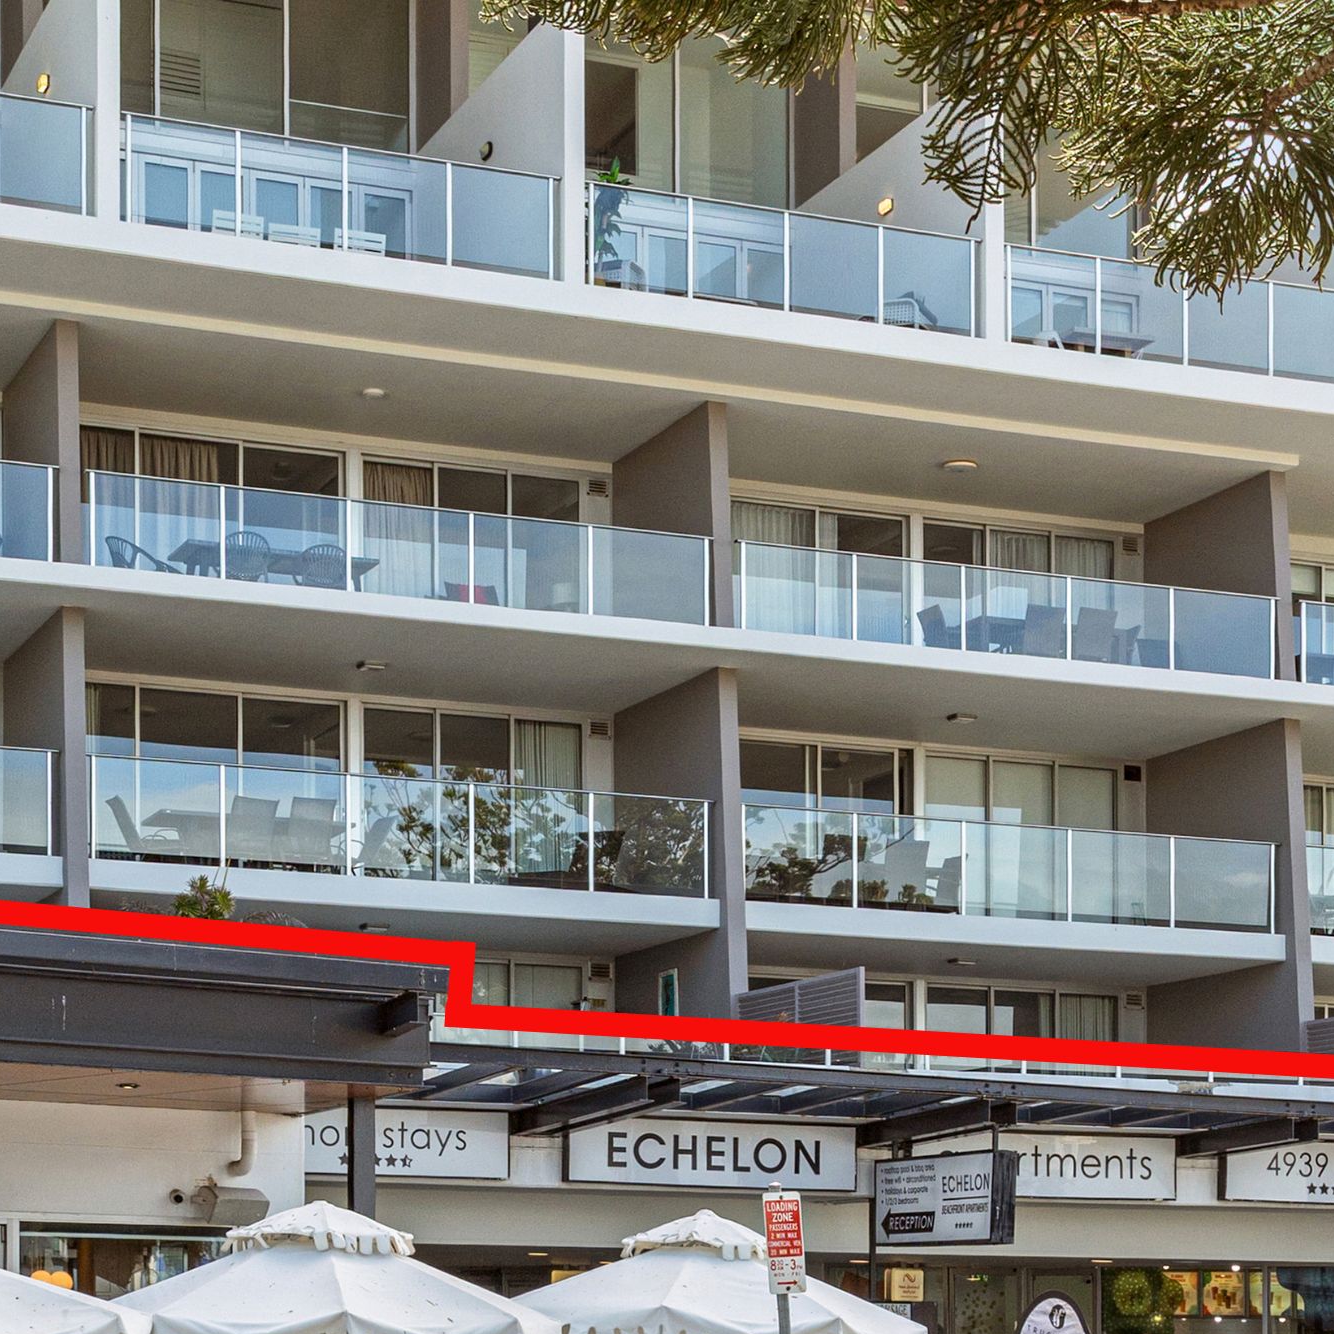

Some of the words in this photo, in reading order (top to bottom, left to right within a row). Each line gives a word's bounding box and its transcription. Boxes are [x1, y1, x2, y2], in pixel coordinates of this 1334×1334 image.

[382, 1121, 467, 1156] stays
[607, 1131, 821, 1175] ECHELON
[1016, 1144, 1152, 1180] rtments
[1266, 1151, 1329, 1178] 4939
[941, 1173, 990, 1193] ECHELON
[766, 1201, 798, 1212] LOADING
[772, 1212, 794, 1222] ZONE
[889, 1215, 934, 1230] RECEPTION
